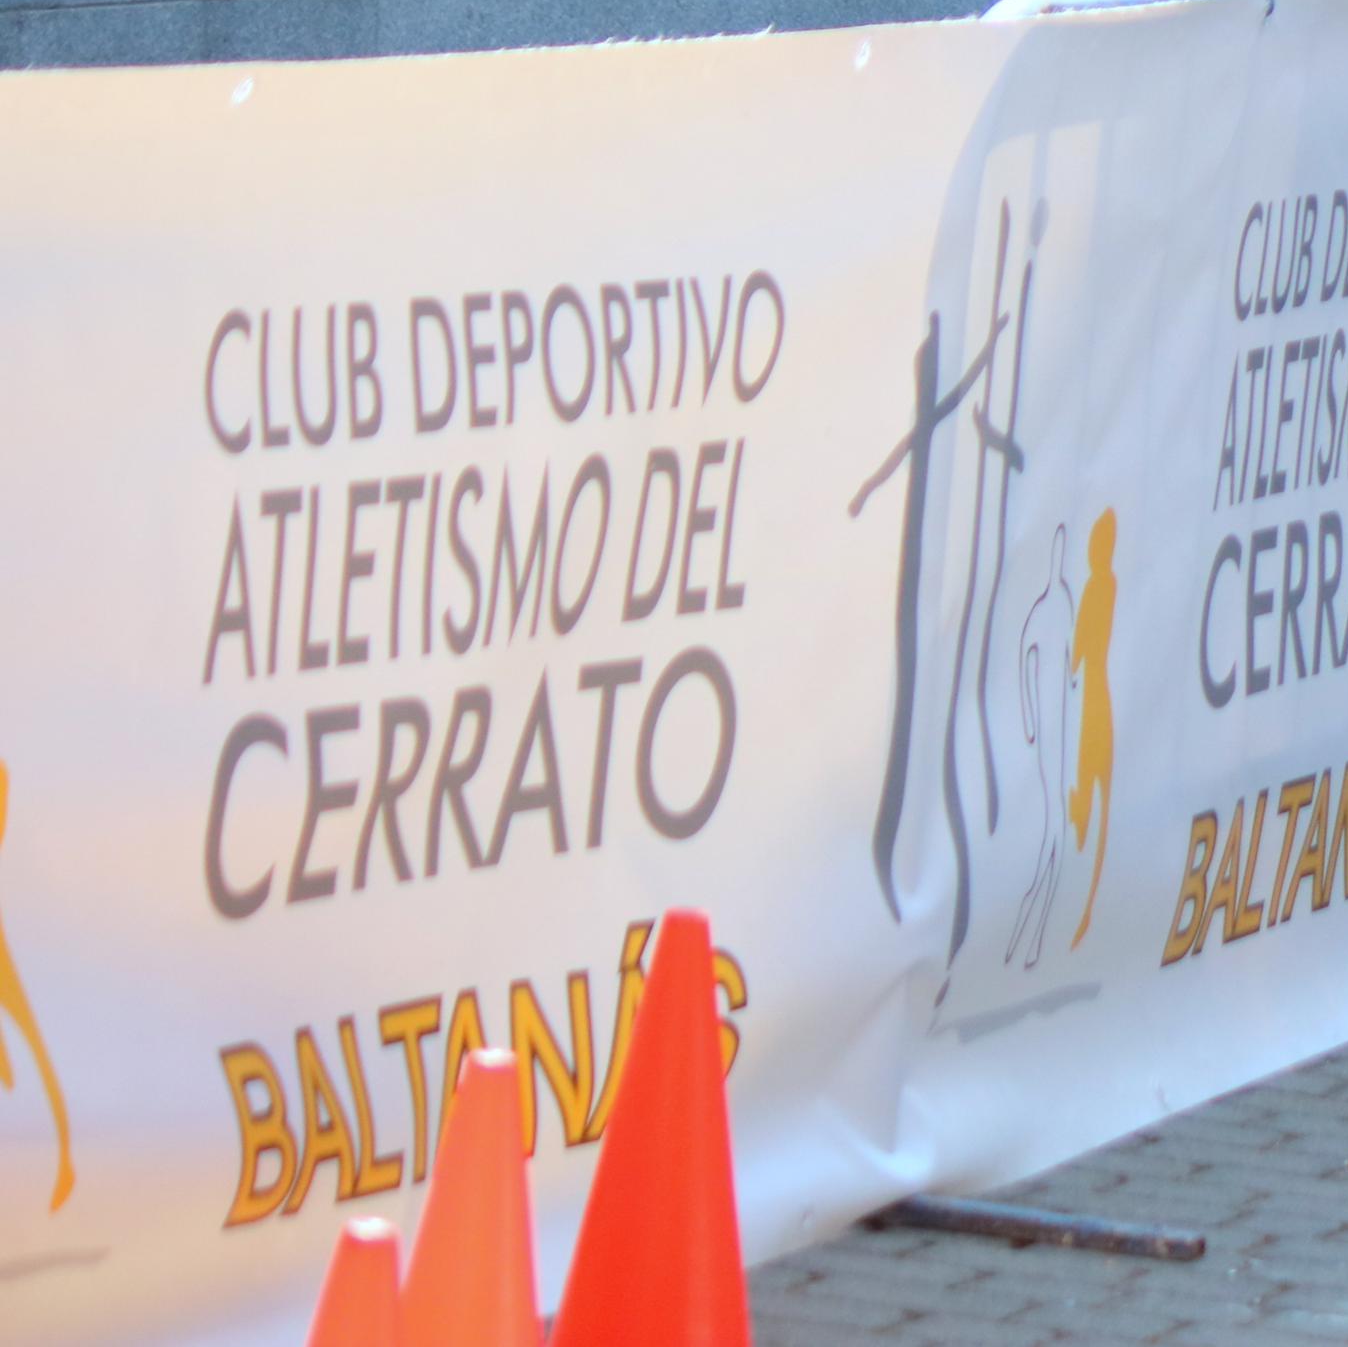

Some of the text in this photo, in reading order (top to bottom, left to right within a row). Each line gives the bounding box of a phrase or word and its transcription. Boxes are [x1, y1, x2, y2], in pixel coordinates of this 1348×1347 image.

[204, 270, 786, 453] CLUB DEPORTIVO
[1232, 193, 1319, 322] CLUB
[202, 437, 747, 686] ATLETISMO DEL
[203, 645, 738, 920] CERRATO
